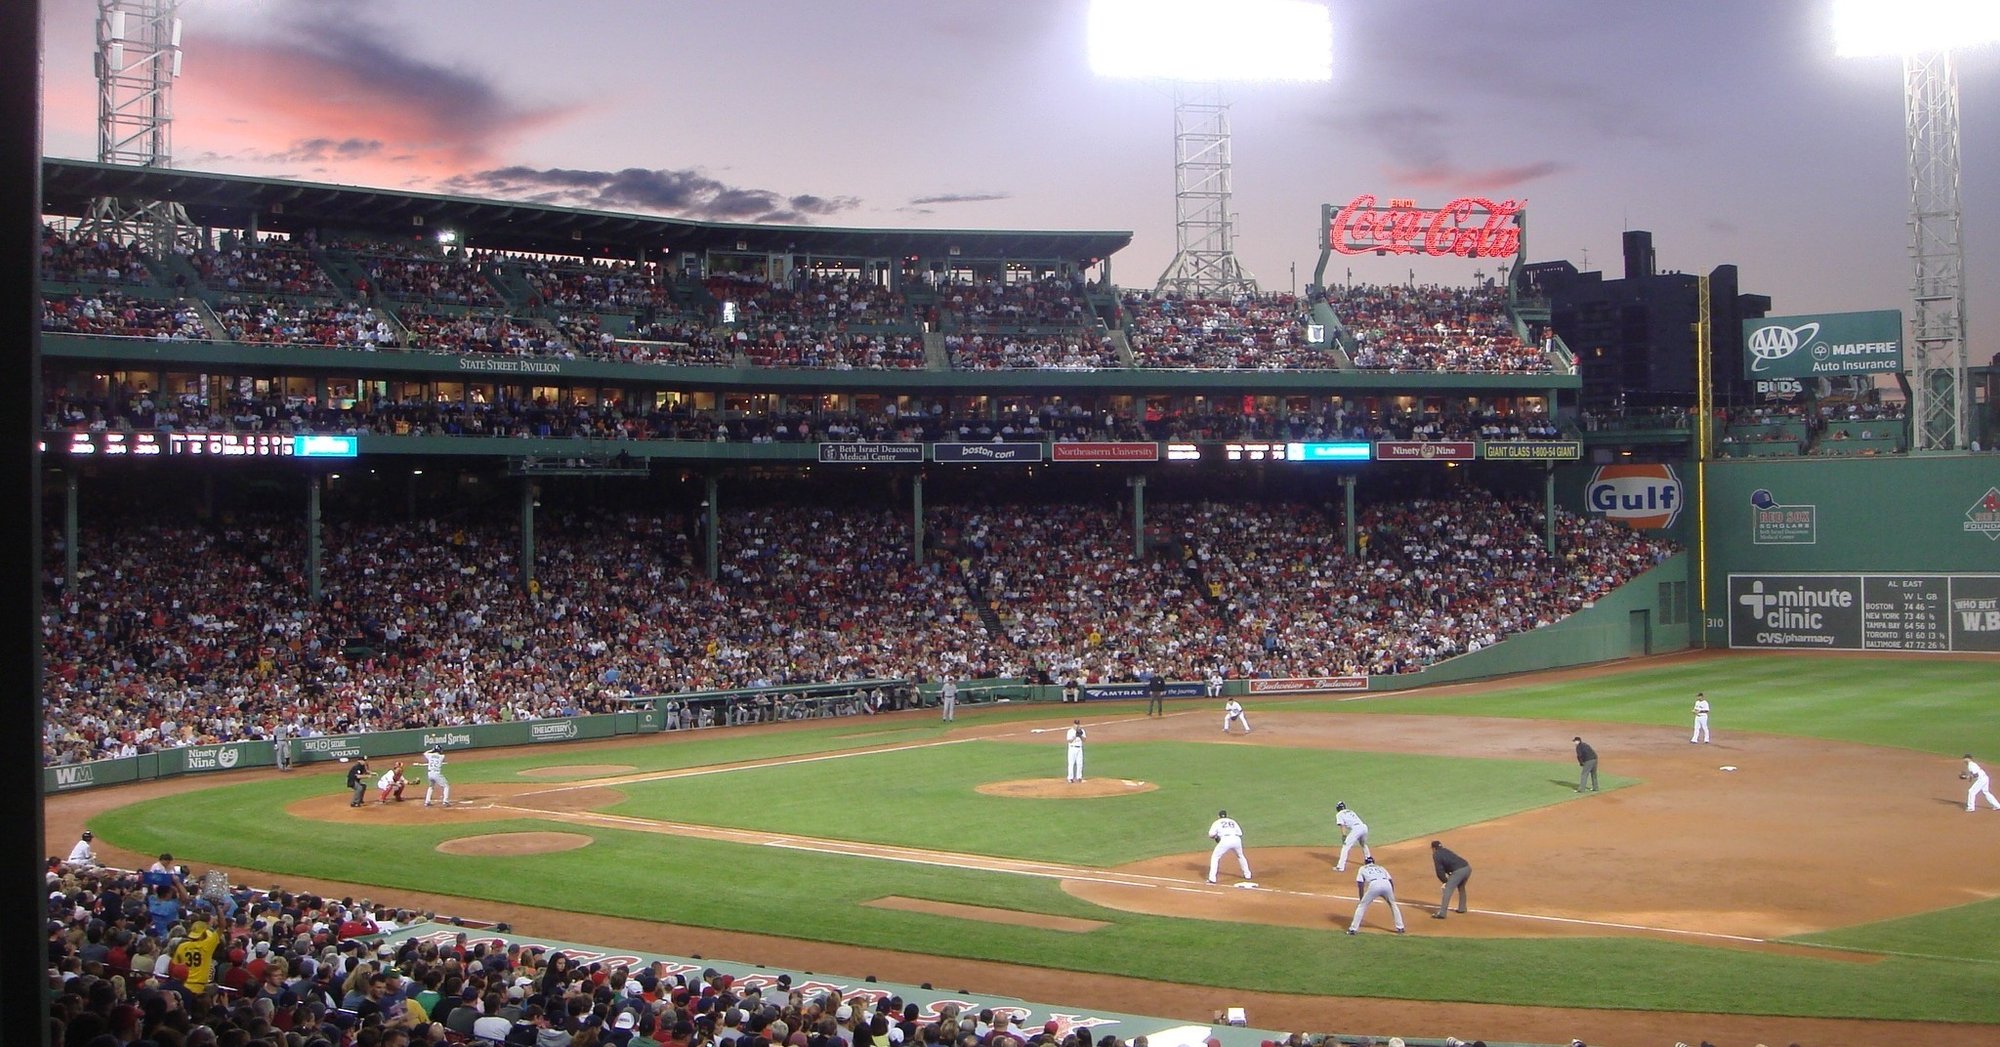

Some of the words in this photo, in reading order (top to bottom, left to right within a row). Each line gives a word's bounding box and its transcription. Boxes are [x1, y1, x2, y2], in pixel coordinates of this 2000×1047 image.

[1330, 193, 1527, 257] Coca-Cola
[1755, 328, 1795, 358] AAA
[1832, 341, 1897, 355] MAPFRE
[460, 358, 486, 370] STATE
[487, 359, 517, 371] STREET
[520, 360, 560, 373] PAVILION
[1813, 361, 1839, 372] Auto
[1843, 359, 1896, 370] Insurance
[1757, 381, 1802, 393] BUDS
[881, 446, 919, 454] Deaconess
[1058, 447, 1110, 456] Northeastern
[1112, 447, 1153, 458] University
[1392, 447, 1420, 456] Ninety
[1436, 447, 1455, 455] Nine
[1488, 447, 1507, 457] GIANT
[1508, 446, 1529, 457] GLASS
[1556, 446, 1576, 457] GIANT
[1592, 484, 1675, 511] Gulf
[1760, 512, 1783, 522] RED
[1787, 512, 1810, 522] SOX
[1779, 585, 1852, 608] minute
[1916, 603, 1925, 611] 46
[1954, 600, 1976, 610] WHO
[1978, 599, 1997, 609] BUT
[1707, 619, 1724, 628] 310
[1767, 608, 1823, 630] clinic
[1757, 632, 1835, 644] CVS/pharmacy
[1866, 641, 1902, 649] BALTIMORE
[448, 733, 470, 744] Spring
[189, 749, 217, 758] Ninety
[189, 758, 216, 768] Nine
[56, 766, 94, 784] WM
[185, 952, 202, 967] 39
